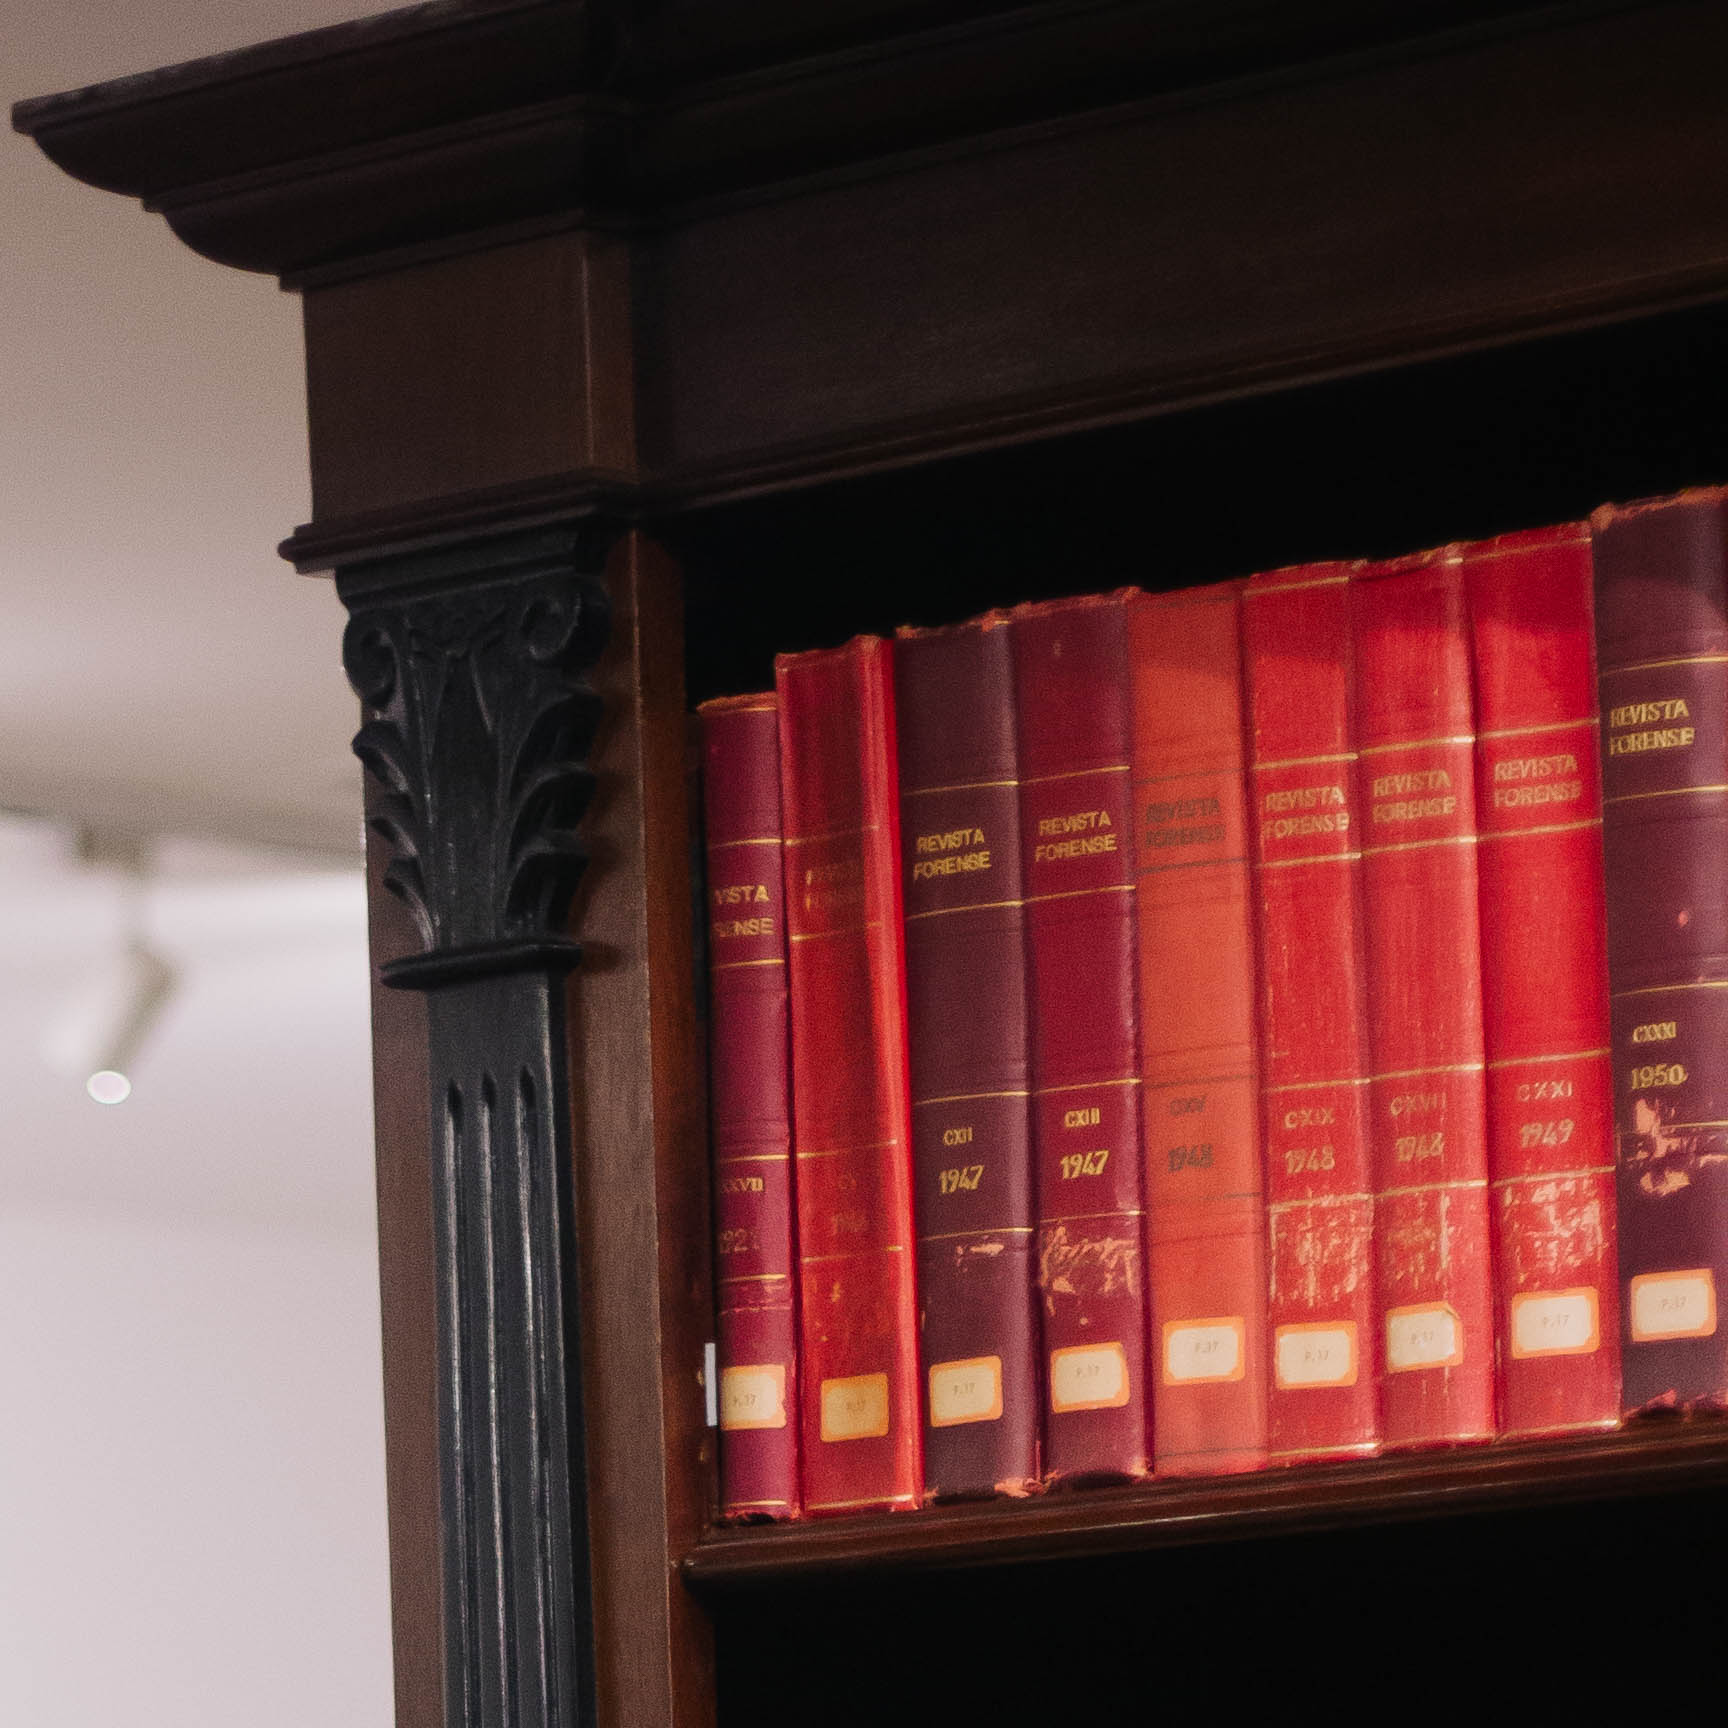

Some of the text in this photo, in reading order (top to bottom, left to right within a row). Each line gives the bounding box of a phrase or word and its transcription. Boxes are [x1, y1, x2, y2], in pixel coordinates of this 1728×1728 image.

[1610, 699, 1691, 728] REVISTA
[1610, 727, 1696, 756] FORENSE
[1494, 754, 1578, 781] REVISTA
[1374, 771, 1452, 797] REVISTA
[1494, 780, 1582, 809] FORENSE
[1265, 785, 1346, 812] REVISTA
[1373, 796, 1457, 823] FORENSE
[1039, 810, 1112, 837] REVISTA
[1263, 810, 1350, 840] FORENSE
[916, 828, 986, 854] REVISTA
[1036, 833, 1118, 862] FORENSE
[913, 850, 992, 881] FORENSE
[1631, 1063, 1684, 1089] 1950
[1517, 1080, 1573, 1102] CXXI
[1064, 1107, 1101, 1128] CXIII
[943, 1127, 973, 1147] CXII
[1520, 1119, 1575, 1148] 1949
[1284, 1148, 1336, 1176] 1948
[1395, 1137, 1445, 1164] 1948
[1059, 1150, 1110, 1180] 1947
[938, 1165, 985, 1194] 1947
